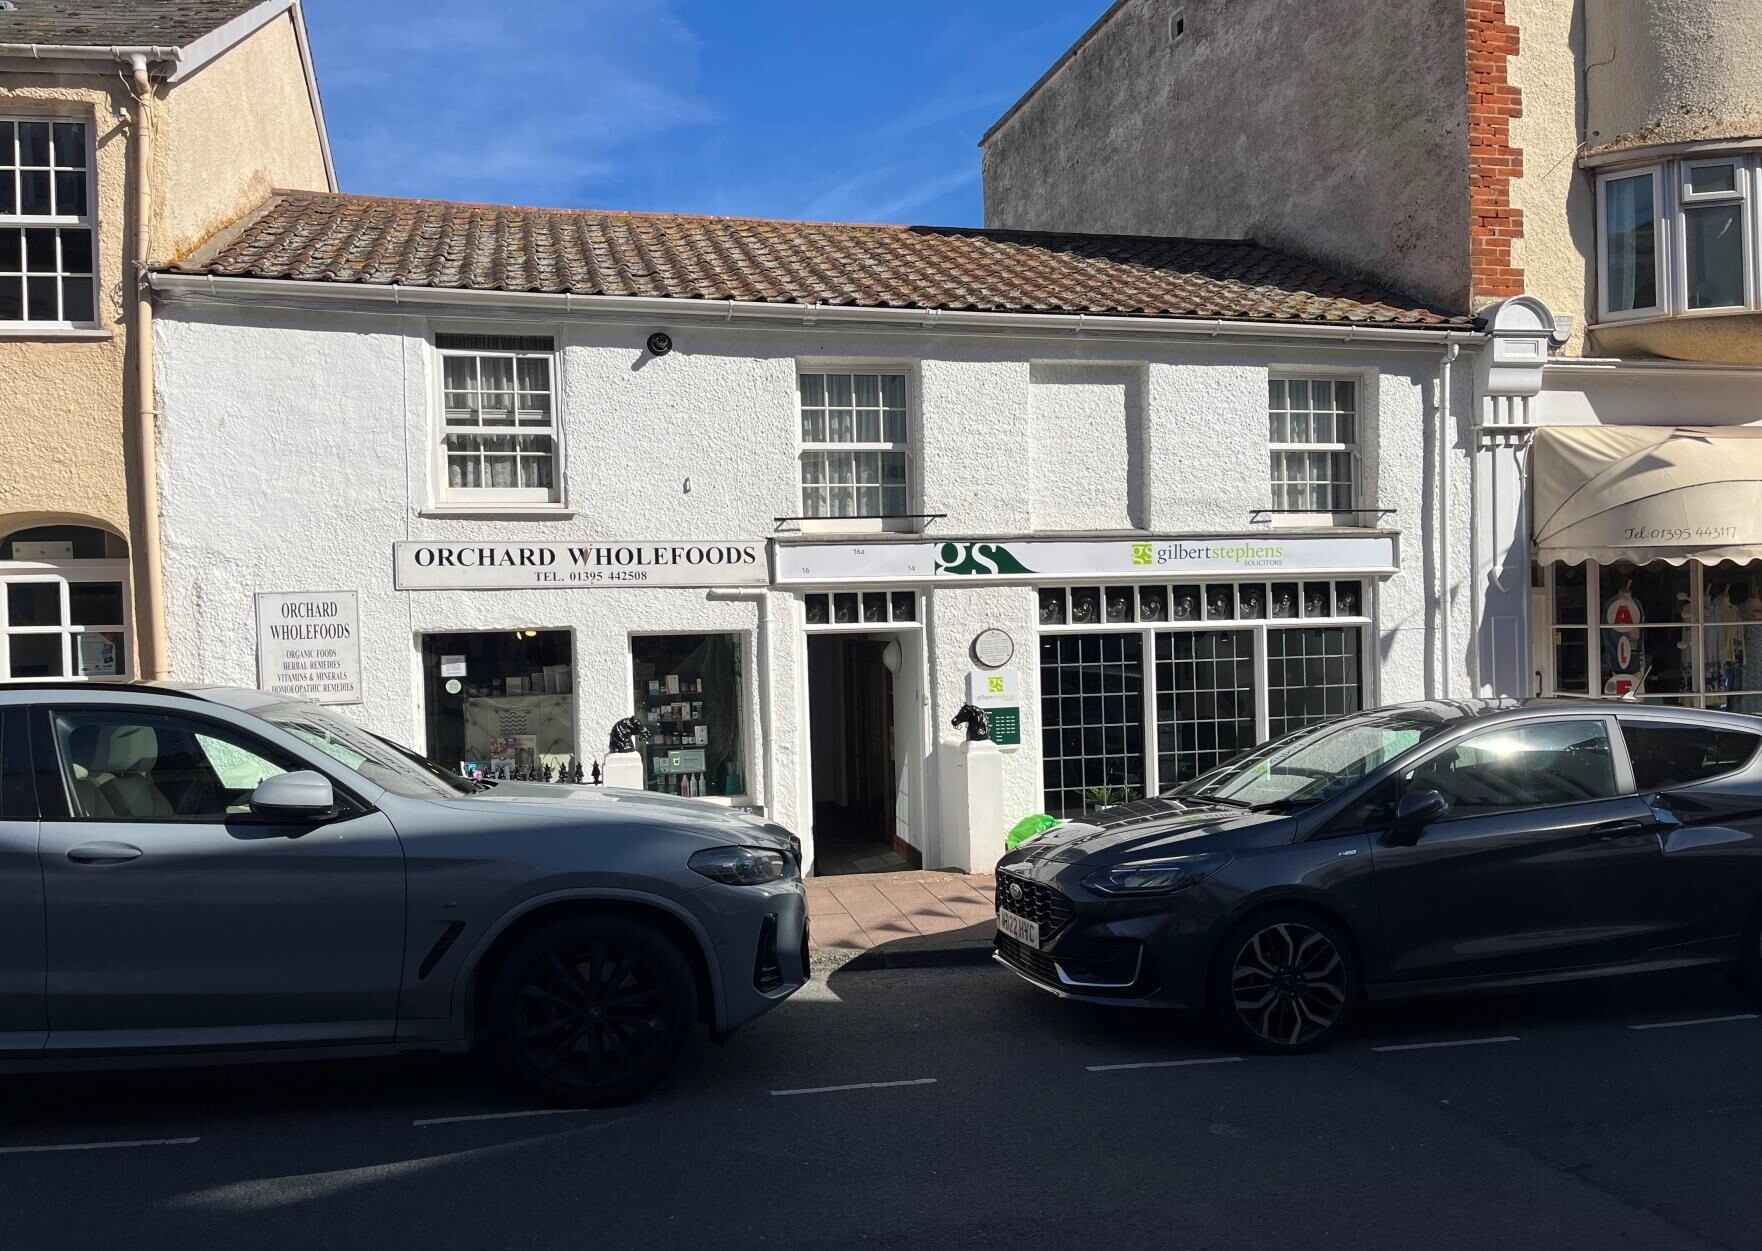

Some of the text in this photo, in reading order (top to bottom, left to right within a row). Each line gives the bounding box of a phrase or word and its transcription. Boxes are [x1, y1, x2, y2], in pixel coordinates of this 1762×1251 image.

[1695, 526, 1737, 539] 443117
[414, 546, 756, 567] ORCHARD WHOLEFOODS
[535, 571, 648, 582] TEL. 01395 442508
[281, 601, 338, 618] ORCHARD
[270, 623, 351, 640] WHOLEFOODS
[286, 648, 337, 659] ORGANIC FOODS
[283, 660, 341, 671] HERBAL REMEDIES
[277, 671, 348, 682] VITAMINS & MINERALS
[271, 682, 354, 695] HOMOEOPATHIC REMEDIES
